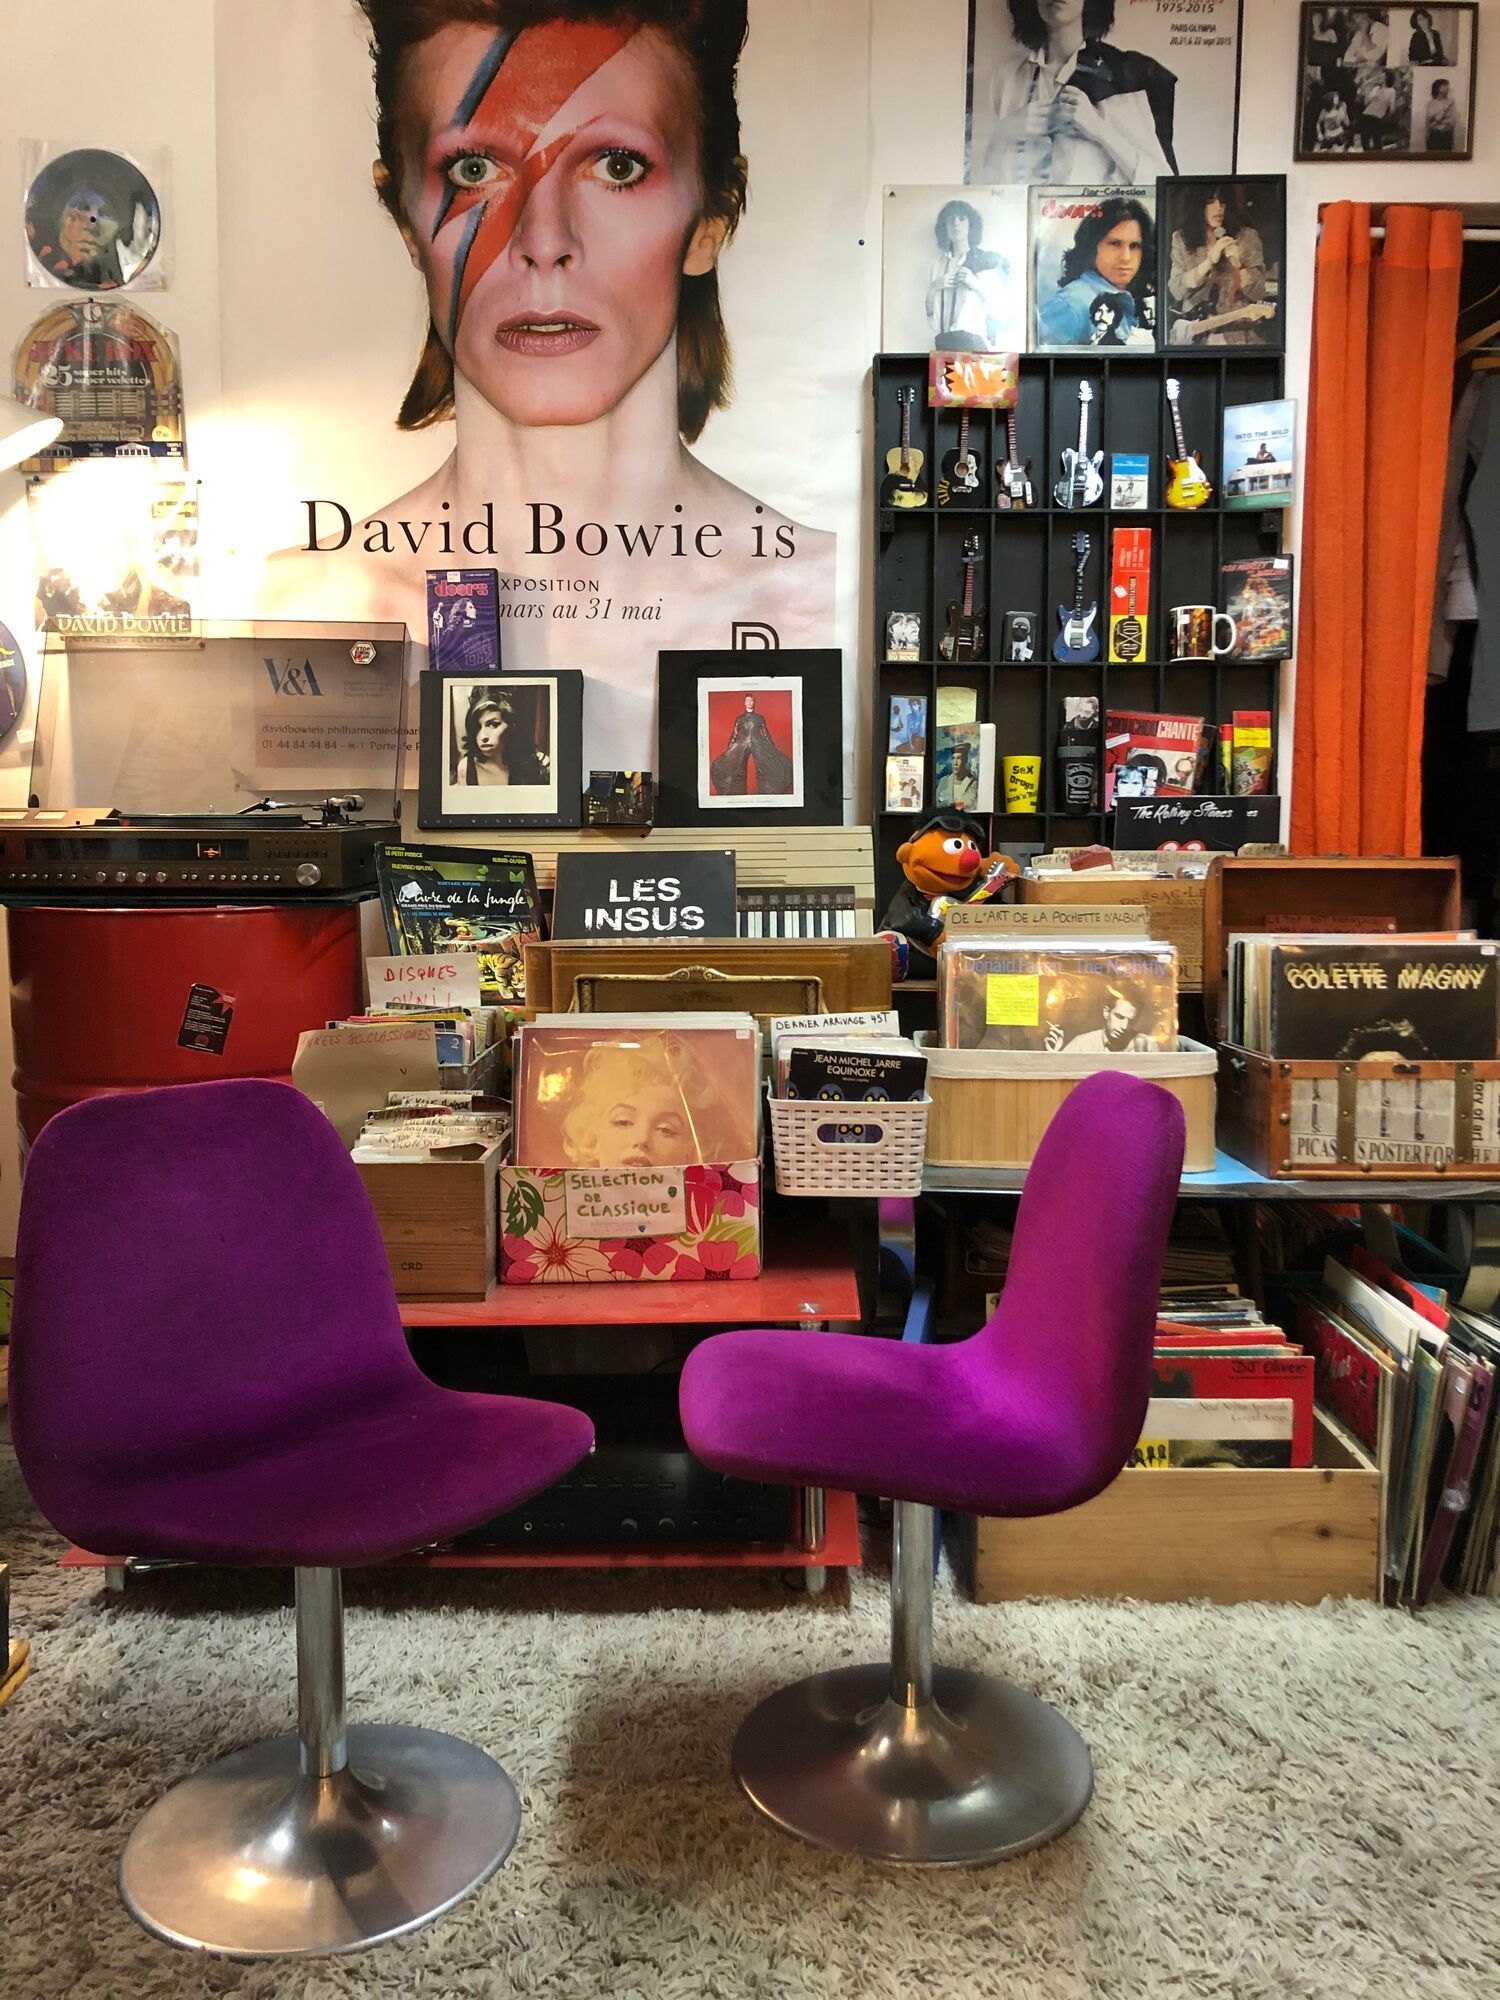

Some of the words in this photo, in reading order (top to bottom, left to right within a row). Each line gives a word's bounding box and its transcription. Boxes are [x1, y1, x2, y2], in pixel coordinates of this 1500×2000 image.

[1235, 432, 1252, 440] INTO
[1254, 430, 1268, 438] THE
[1271, 428, 1289, 436] WILD
[301, 500, 498, 556] David
[525, 503, 723, 558] Bowie
[751, 506, 796, 558] is
[434, 580, 489, 597] doors
[500, 578, 600, 593] XPOSITION
[553, 603, 578, 620] au
[585, 598, 611, 621] 31
[621, 599, 662, 621] mai
[56, 613, 119, 634] DAVID
[121, 611, 190, 633] BOWIE
[262, 657, 324, 697] V&A
[1156, 721, 1200, 742] CHANTE
[262, 740, 273, 749] 01
[277, 740, 289, 749] 44
[292, 740, 305, 749] 84
[309, 740, 321, 749] 44
[325, 740, 337, 749] 84
[370, 741, 395, 750] Porte
[1009, 775, 1035, 790] Drugs
[1130, 804, 1154, 820] The
[1153, 802, 1192, 825] Rolling
[1193, 801, 1234, 818] Stones
[609, 877, 681, 902] LES
[447, 892, 464, 903] de
[467, 887, 480, 903] la
[484, 887, 526, 913] jungle
[584, 905, 705, 932] INSUS
[951, 911, 968, 925] DE
[974, 910, 1011, 923] L'ART
[1013, 911, 1028, 923] DE
[1033, 911, 1048, 922] LA
[1052, 910, 1101, 923] POCHETTE
[963, 958, 1015, 973] Donald
[1077, 959, 1103, 972] The
[1107, 958, 1168, 977] Nightfly
[1286, 966, 1388, 990] COLETTE
[1397, 965, 1485, 990] MAGNY
[450, 1037, 460, 1049] 2
[813, 1054, 838, 1064] JEAN
[838, 1056, 873, 1067] MICHEL
[874, 1058, 901, 1070] JARRE
[827, 1065, 877, 1077] EQUINOXE
[879, 1070, 886, 1078] 4
[1368, 1143, 1424, 1162] POSTER
[1424, 1146, 1455, 1163] FOR
[584, 1193, 602, 1203] DE
[401, 1262, 423, 1271] CRD
[1231, 1360, 1257, 1374] DJ
